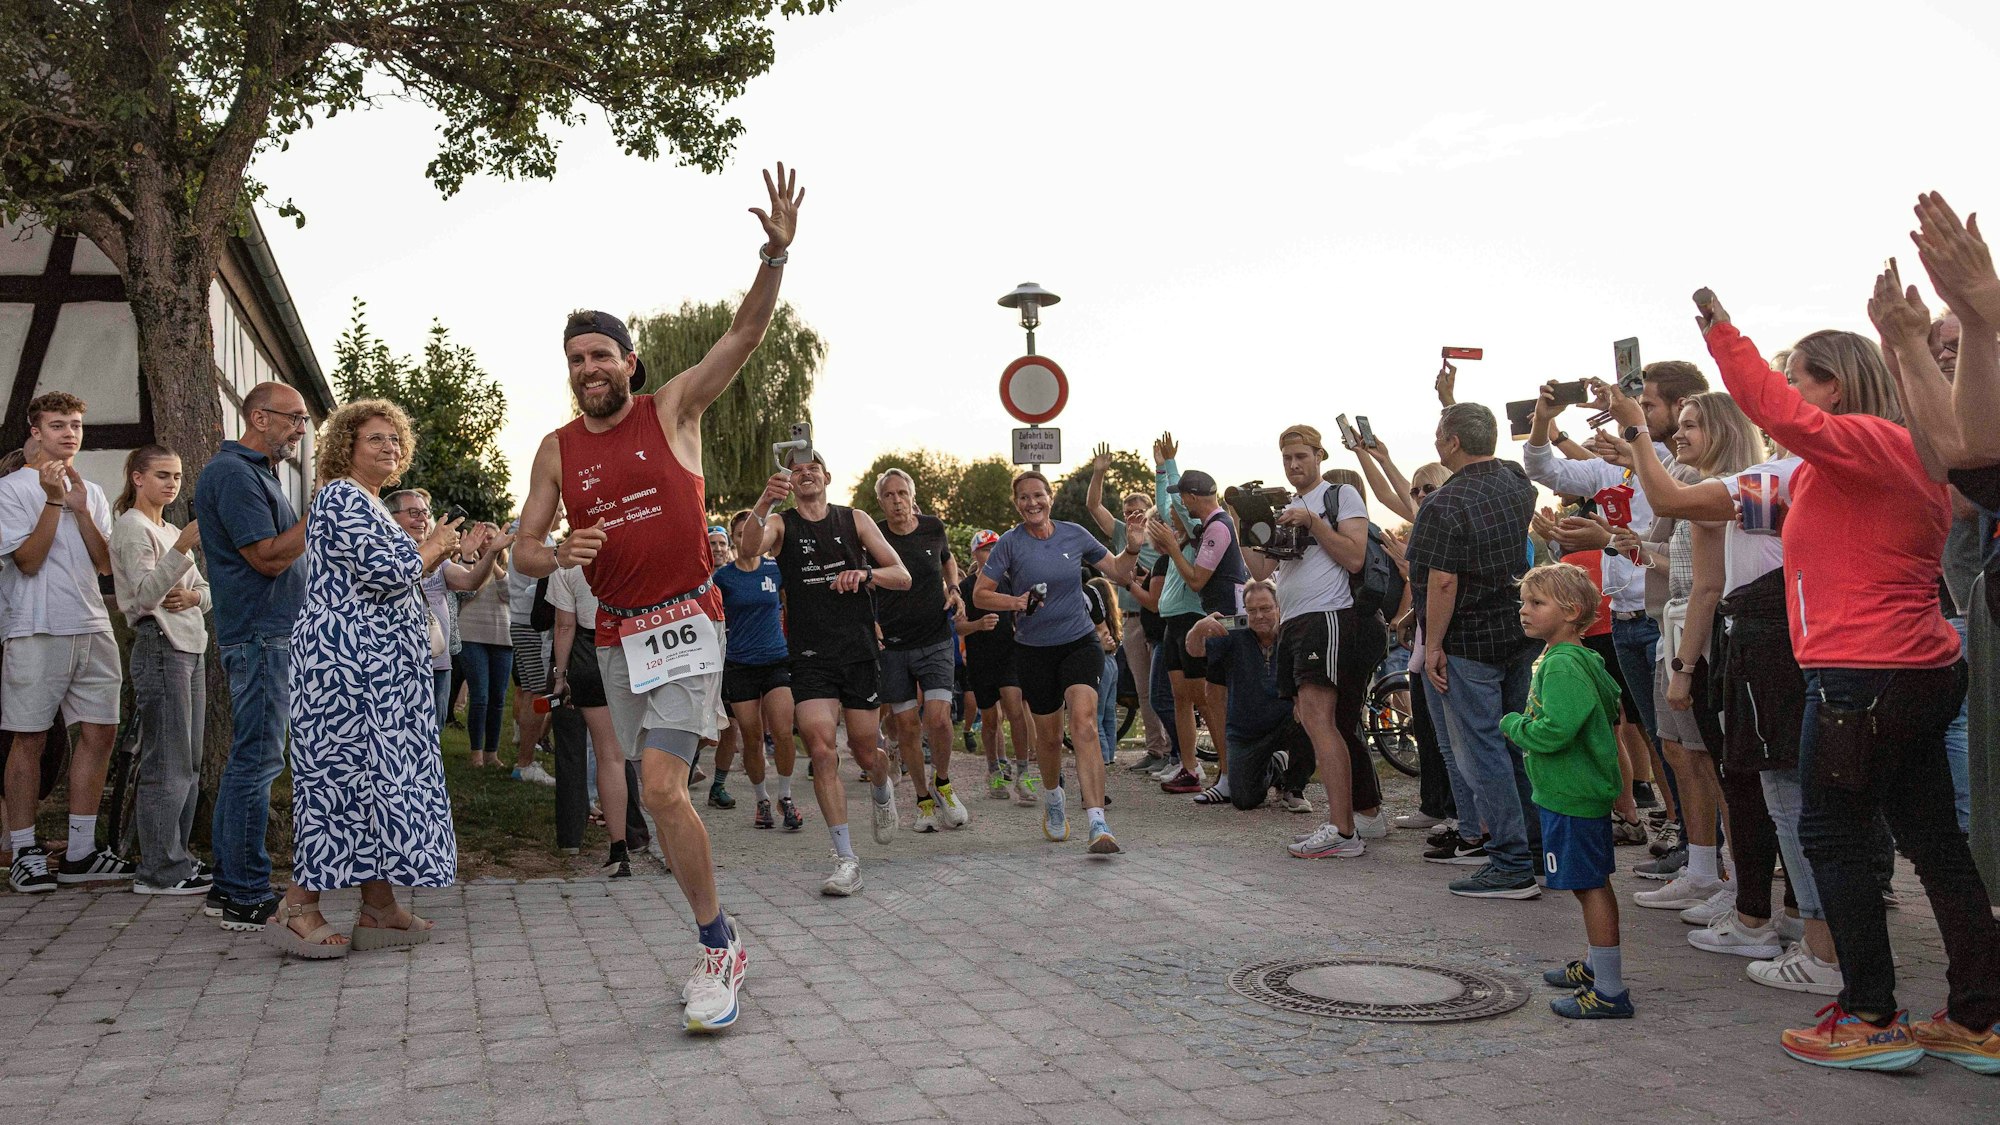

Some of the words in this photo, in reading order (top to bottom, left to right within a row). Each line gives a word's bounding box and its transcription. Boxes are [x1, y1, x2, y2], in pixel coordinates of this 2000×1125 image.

[1045, 431, 1054, 439] bis
[1020, 442, 1053, 451] Parkplätze
[1030, 452, 1044, 460] frei
[578, 464, 602, 477] ROTH
[621, 487, 657, 504] SHIMANO
[586, 500, 618, 516] HISCOX
[626, 505, 662, 521] doujak.eu
[636, 604, 693, 631] ROTH
[645, 624, 697, 655] 106
[646, 658, 663, 670] 120
[1867, 1027, 1907, 1046] HOKA
